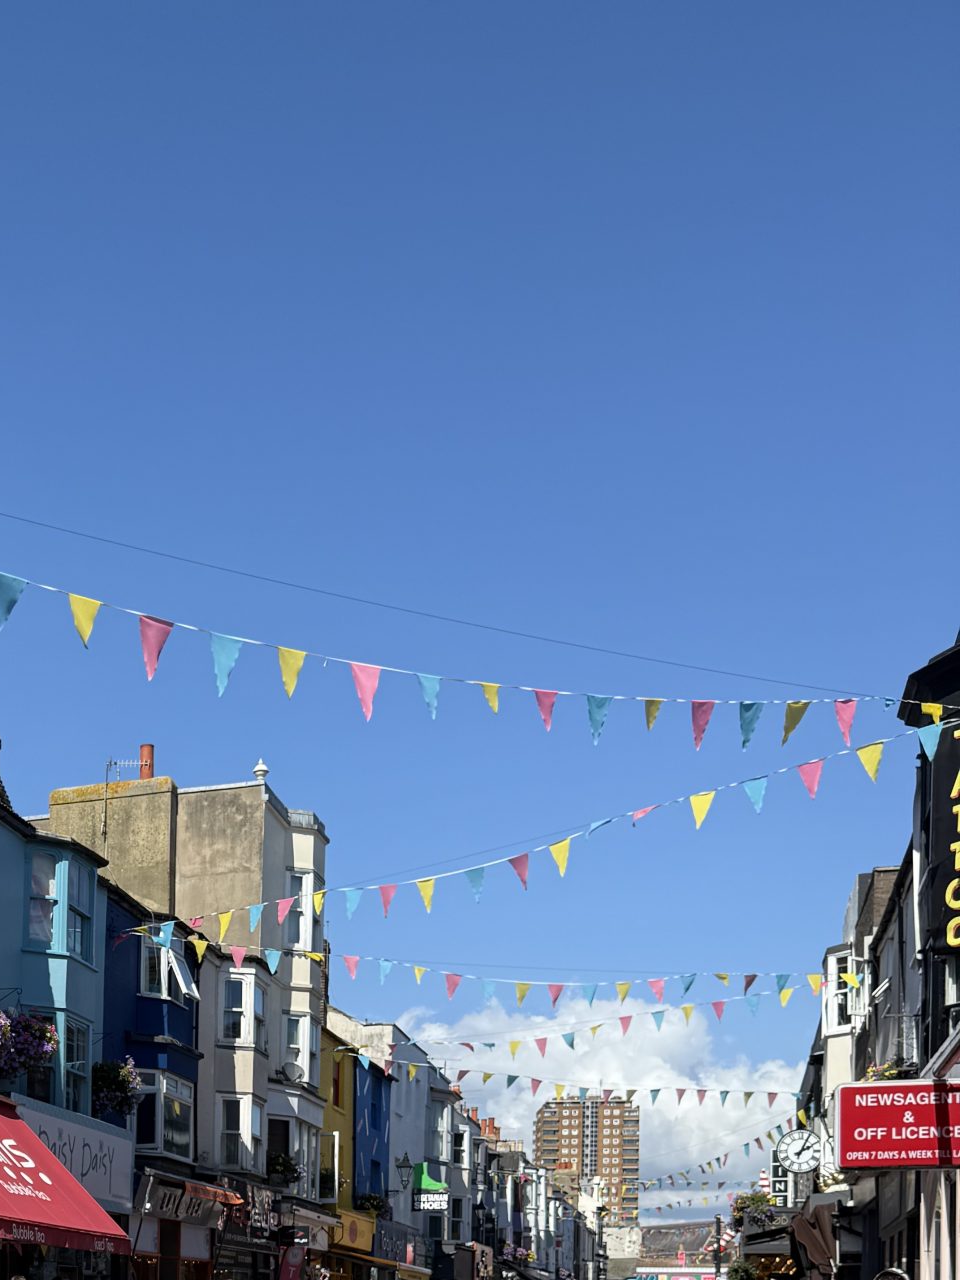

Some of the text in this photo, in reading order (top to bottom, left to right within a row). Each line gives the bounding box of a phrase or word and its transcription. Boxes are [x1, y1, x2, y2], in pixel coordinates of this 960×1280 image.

[903, 1110, 914, 1123] &
[853, 1127, 888, 1141] OFF
[846, 1151, 870, 1161] OPEN
[870, 1151, 876, 1160] 7
[877, 1151, 899, 1159] DAYS
[900, 1151, 906, 1159] A
[907, 1150, 933, 1159] WEEK
[414, 1201, 448, 1210] SHOES
[12, 1223, 35, 1241] Bubble
[34, 1227, 45, 1243] Tea
